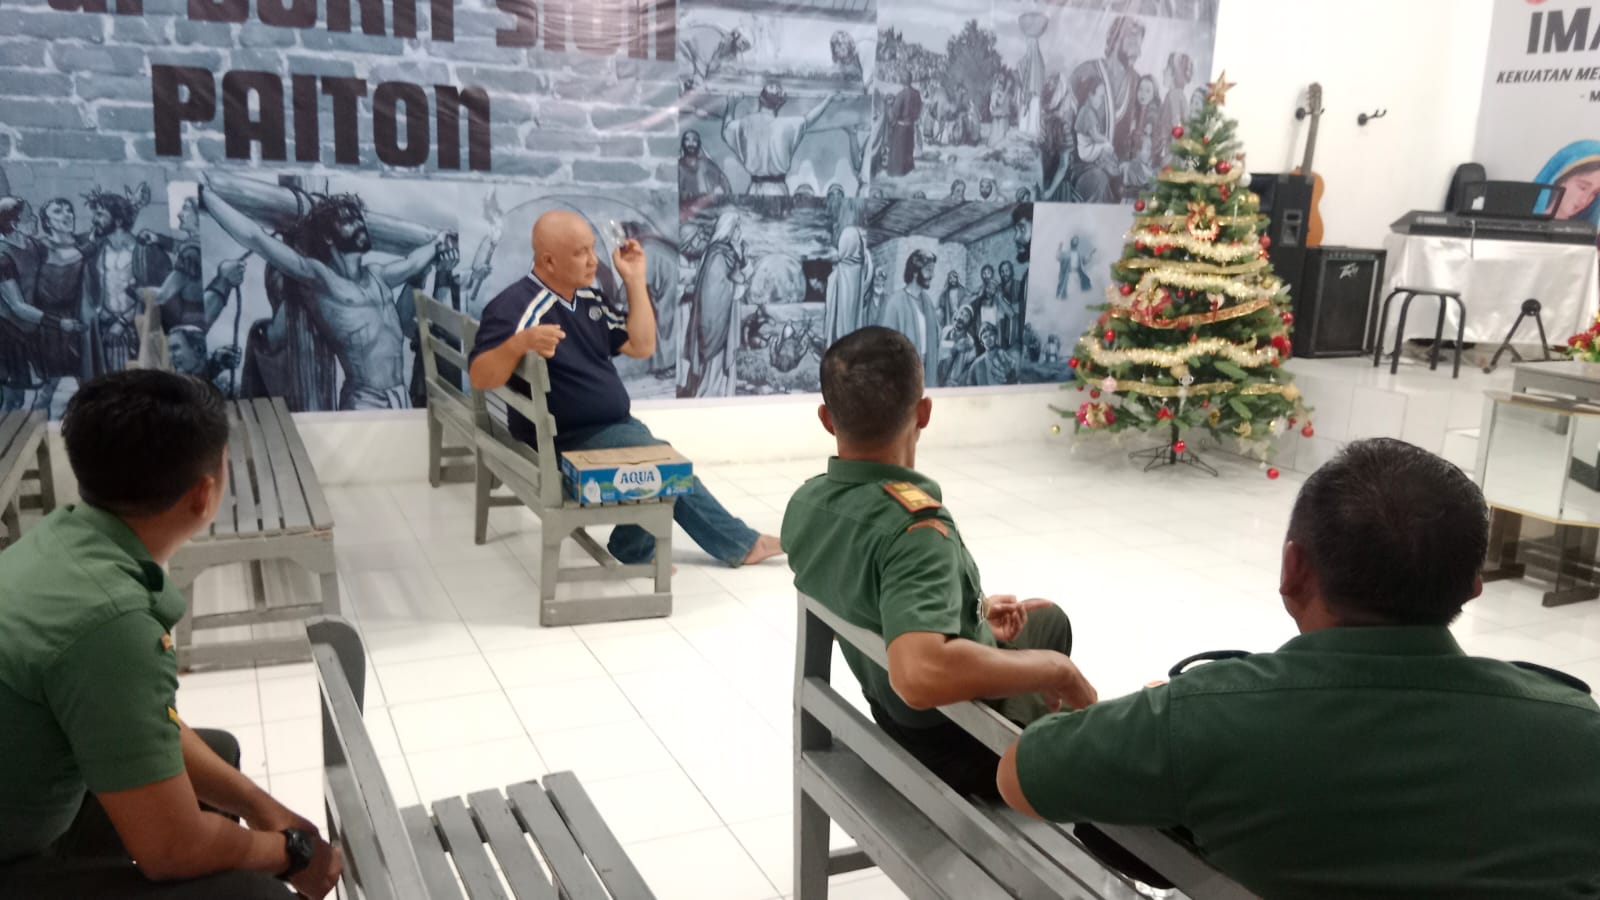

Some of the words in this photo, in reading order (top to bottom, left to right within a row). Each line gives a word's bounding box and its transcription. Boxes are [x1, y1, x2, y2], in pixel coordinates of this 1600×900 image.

[1527, 7, 1600, 54] IM
[1496, 68, 1572, 84] KEKUATAN
[1575, 67, 1600, 81] ME
[620, 471, 655, 484] AQUA
